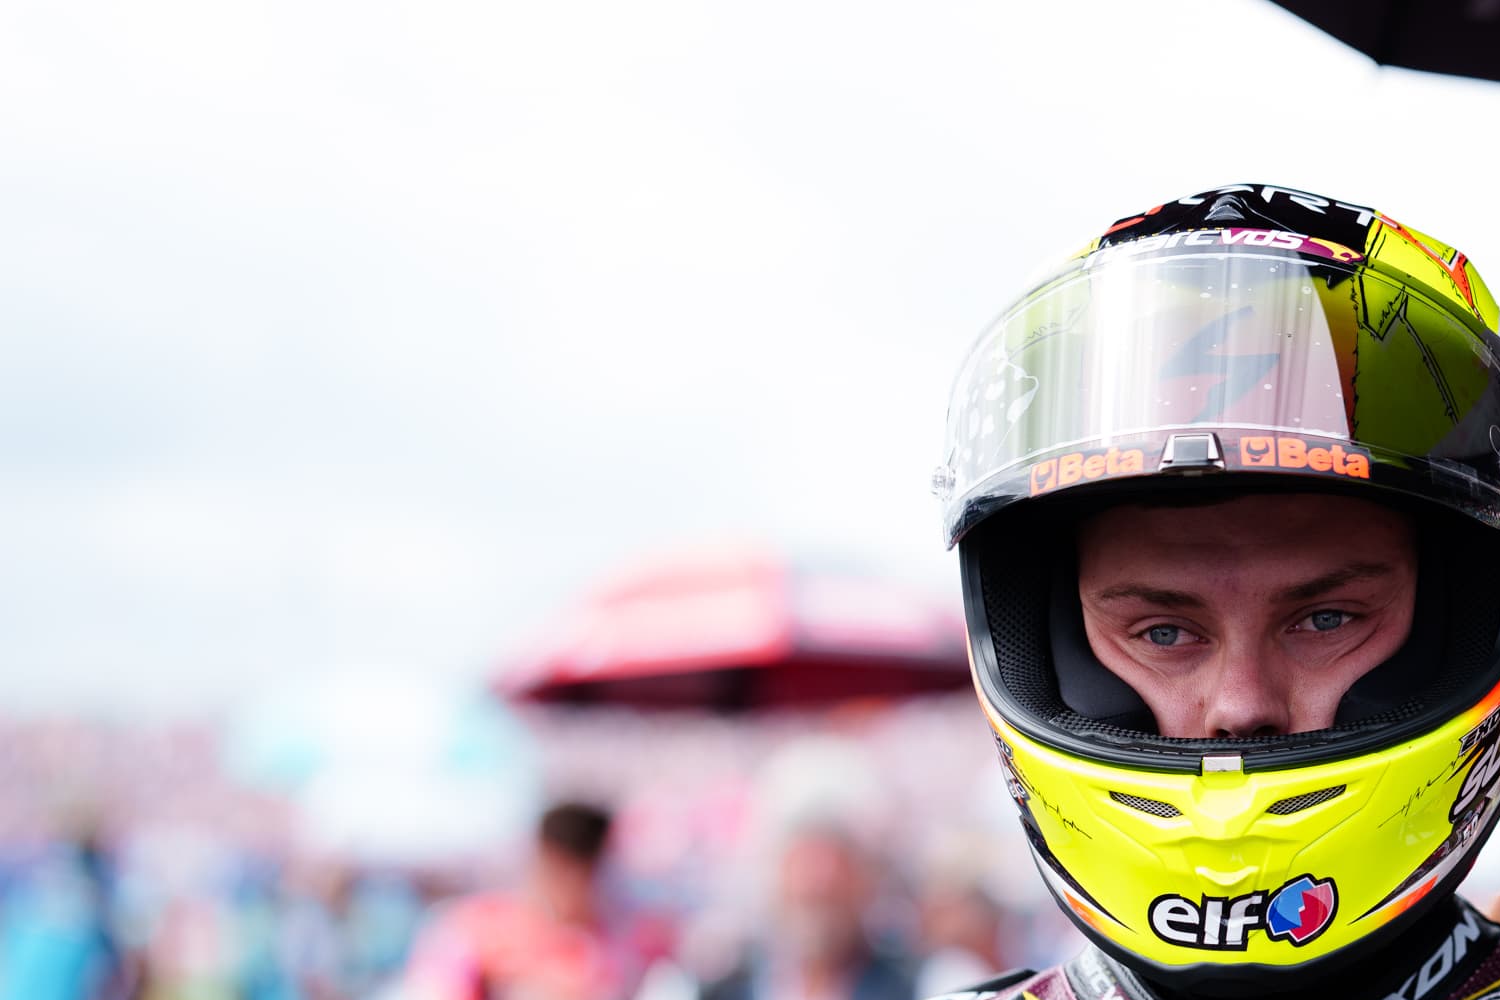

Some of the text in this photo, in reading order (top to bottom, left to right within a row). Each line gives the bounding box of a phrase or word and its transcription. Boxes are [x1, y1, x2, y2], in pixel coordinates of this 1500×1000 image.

[1058, 446, 1144, 485] Beta
[1277, 437, 1370, 479] Beta
[1152, 895, 1263, 945] elf
